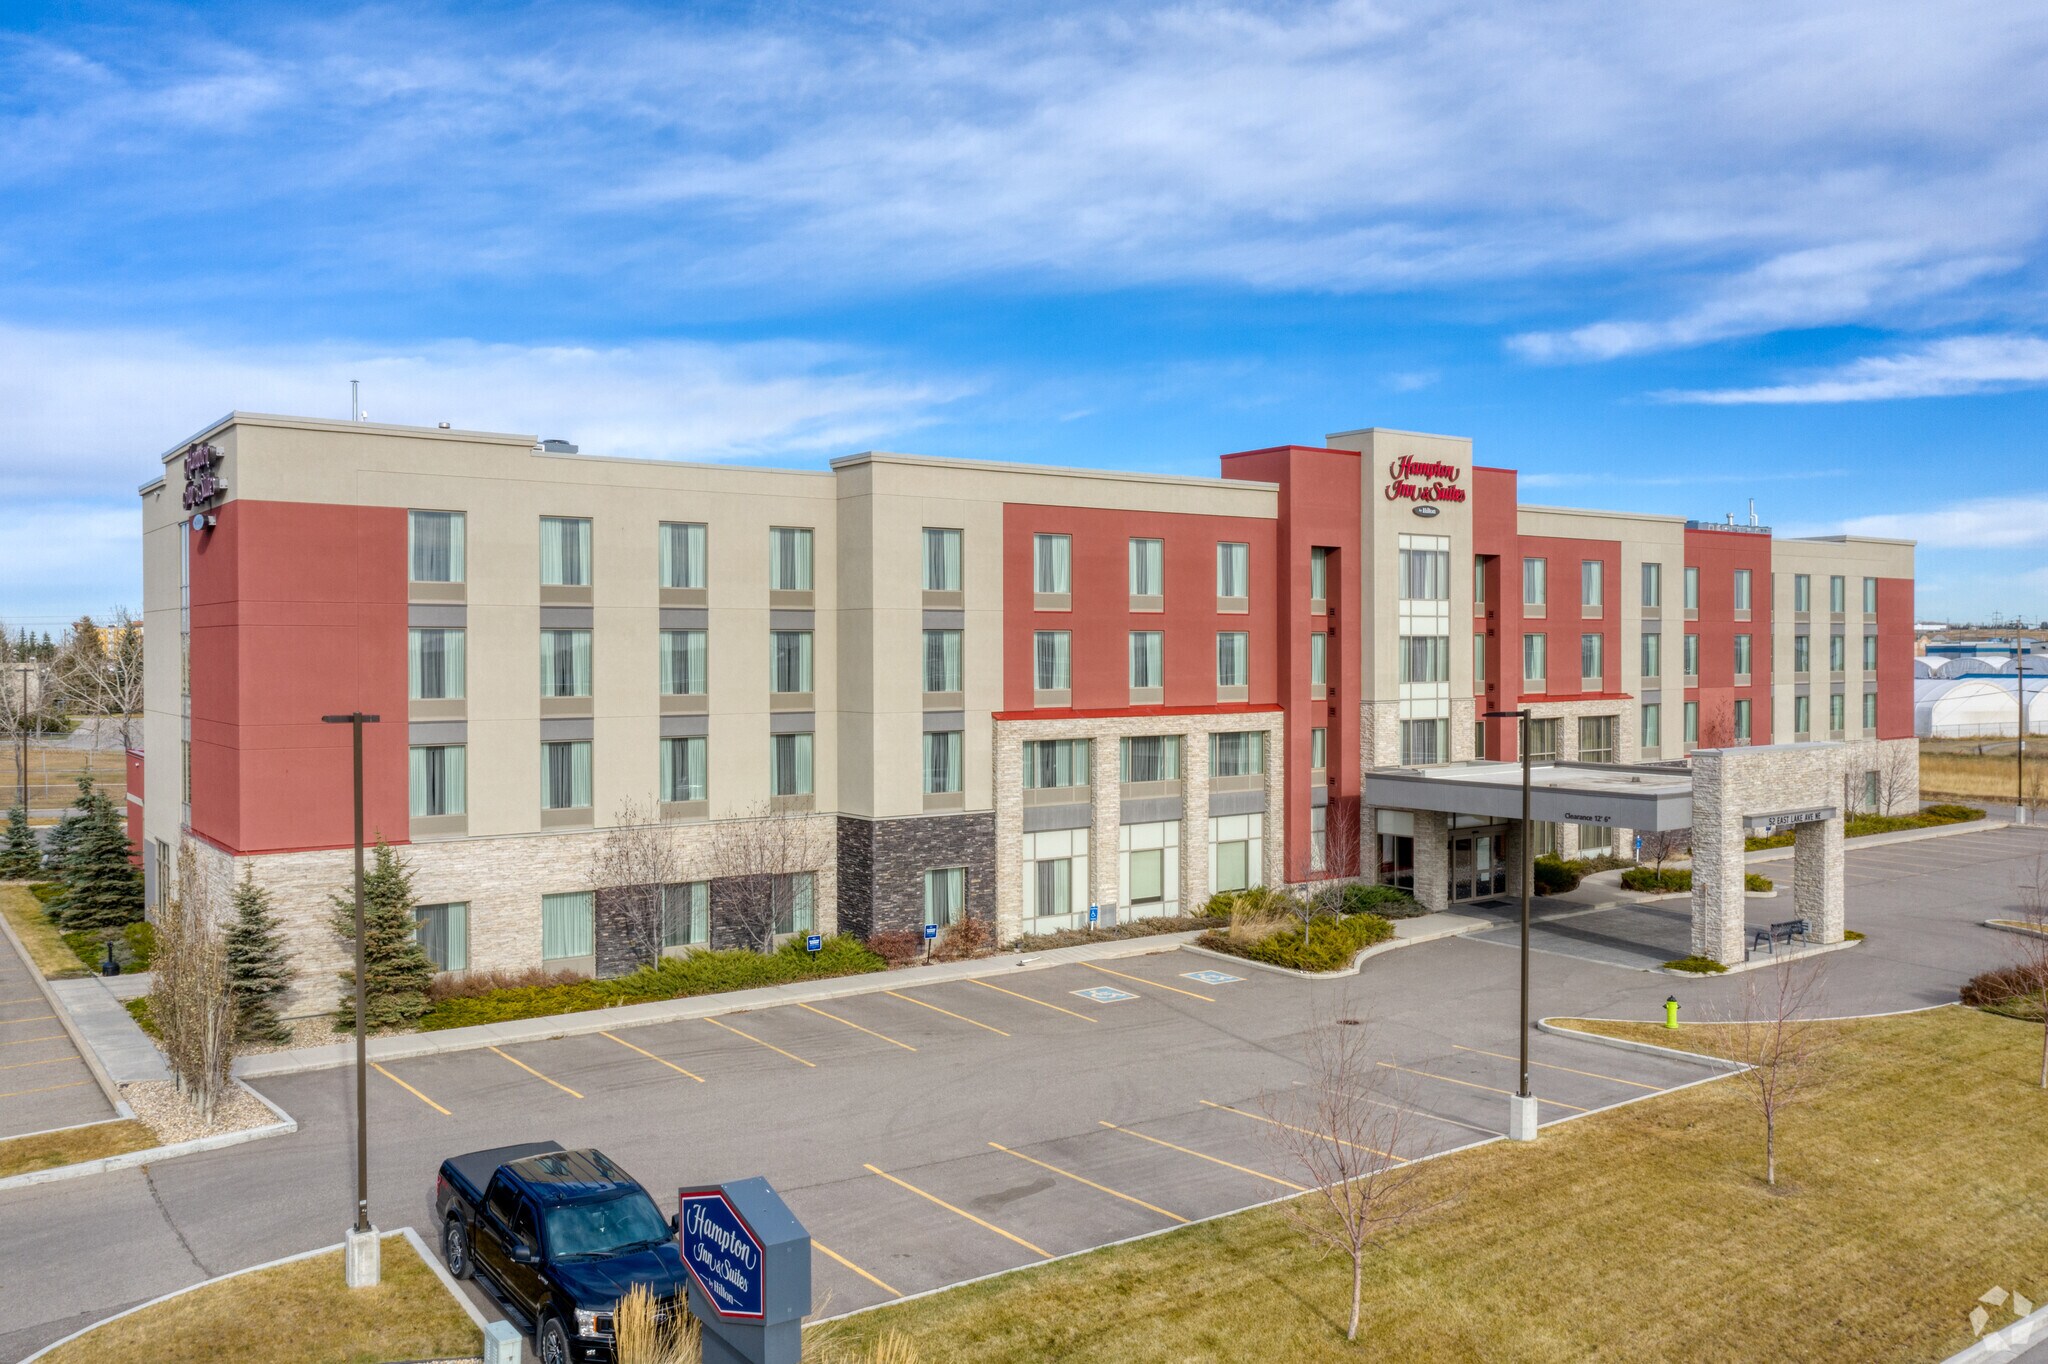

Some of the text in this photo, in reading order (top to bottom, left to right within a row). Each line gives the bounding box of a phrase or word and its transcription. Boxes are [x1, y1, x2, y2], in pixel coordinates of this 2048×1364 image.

[1389, 454, 1460, 482] Hampton
[1384, 479, 1422, 502] Inn
[1429, 481, 1466, 503] Suites
[1564, 812, 1593, 821] Clearance
[1777, 815, 1789, 825] EAST
[1790, 813, 1803, 823] LAKE
[1804, 812, 1813, 821] AVE
[1814, 811, 1821, 820] NE
[686, 1203, 757, 1271] Hampton
[693, 1242, 749, 1293] Inn & Suites
[713, 1279, 734, 1305] Hilton
